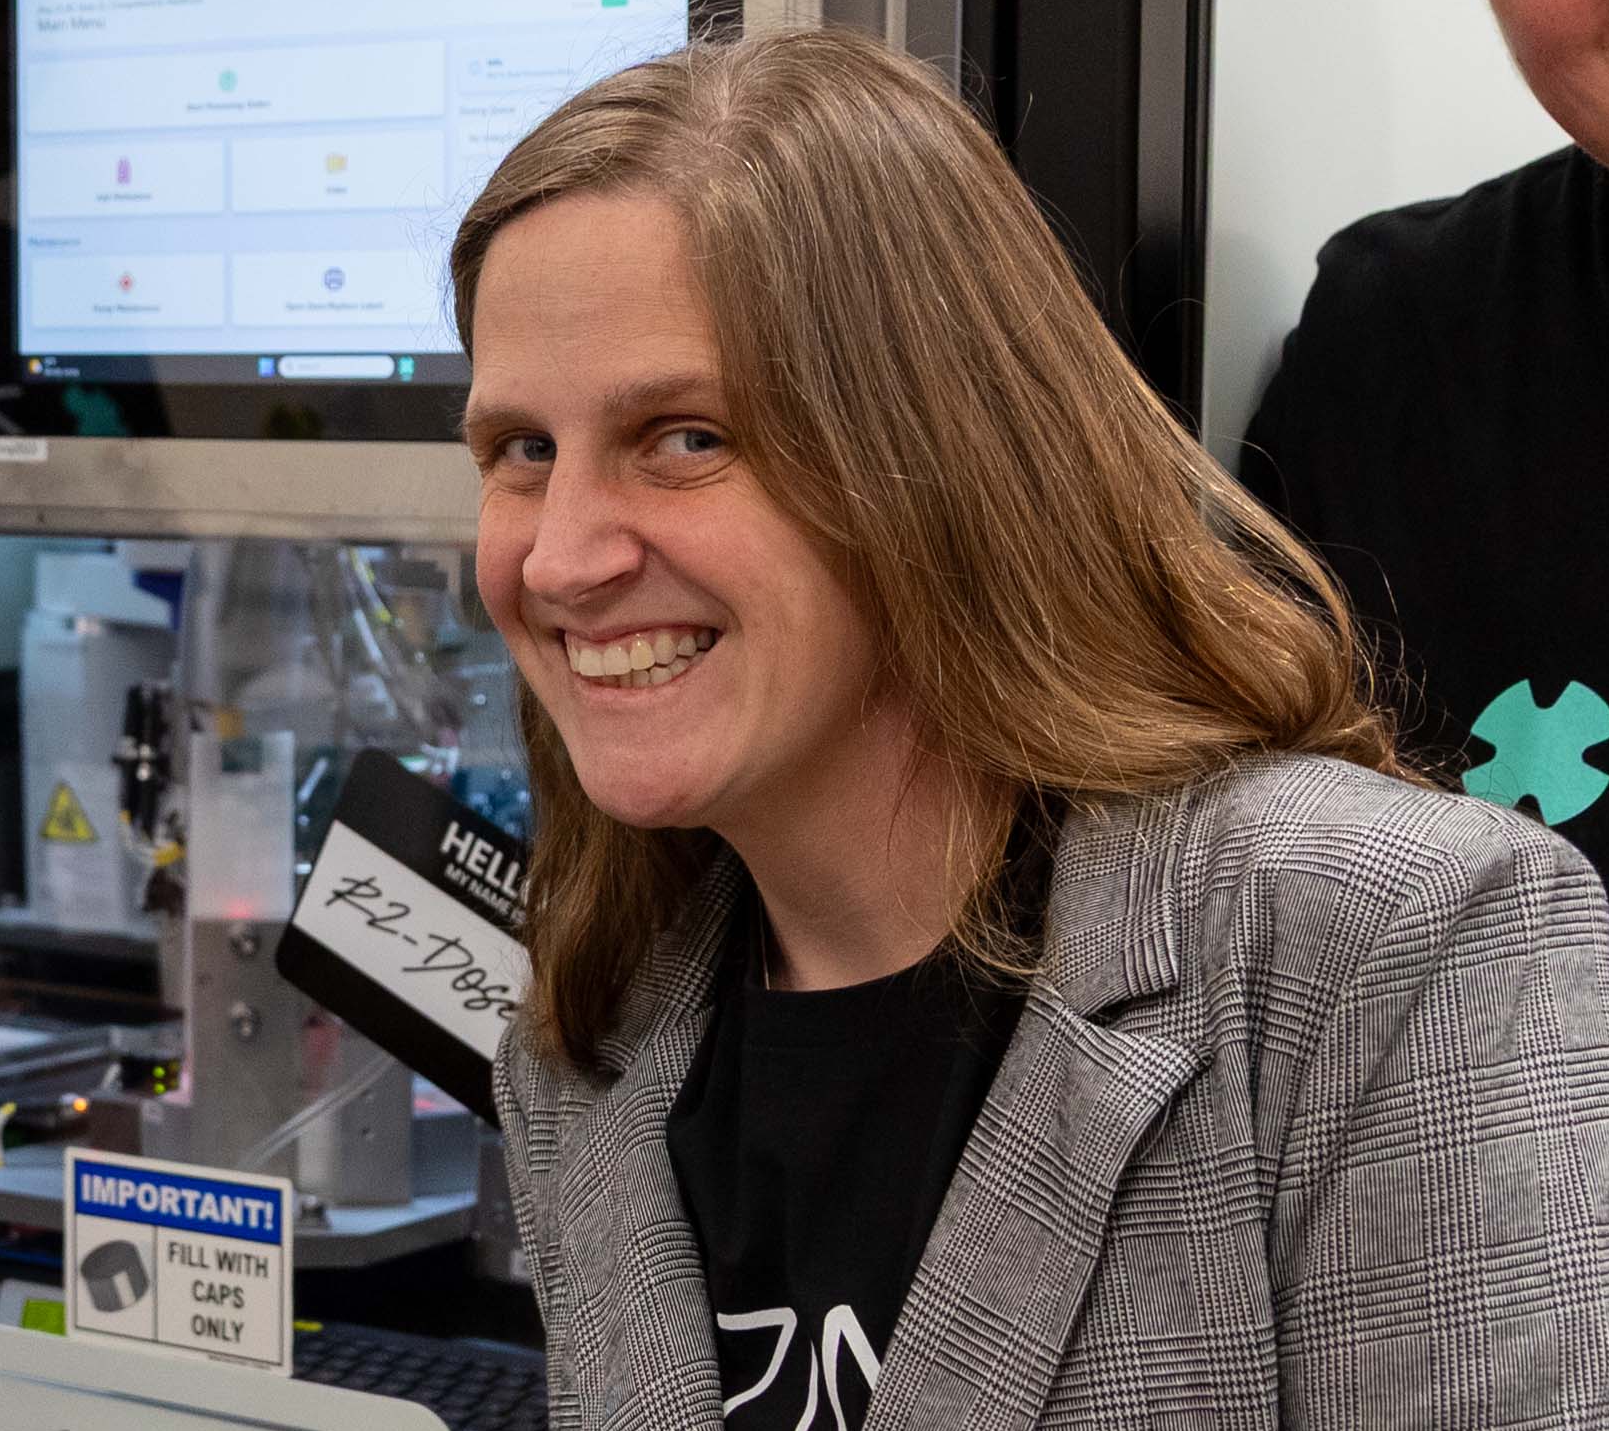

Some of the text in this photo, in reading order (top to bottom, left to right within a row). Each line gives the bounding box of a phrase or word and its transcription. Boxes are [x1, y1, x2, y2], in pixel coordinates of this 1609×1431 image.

[439, 820, 526, 903] HELL
[443, 863, 470, 887] MY
[468, 878, 511, 916] NAME
[81, 1173, 274, 1231] IMPORTANT!
[168, 1241, 269, 1279] FILL WITH
[192, 1280, 245, 1309] CAPS
[191, 1314, 245, 1344] ONLY
